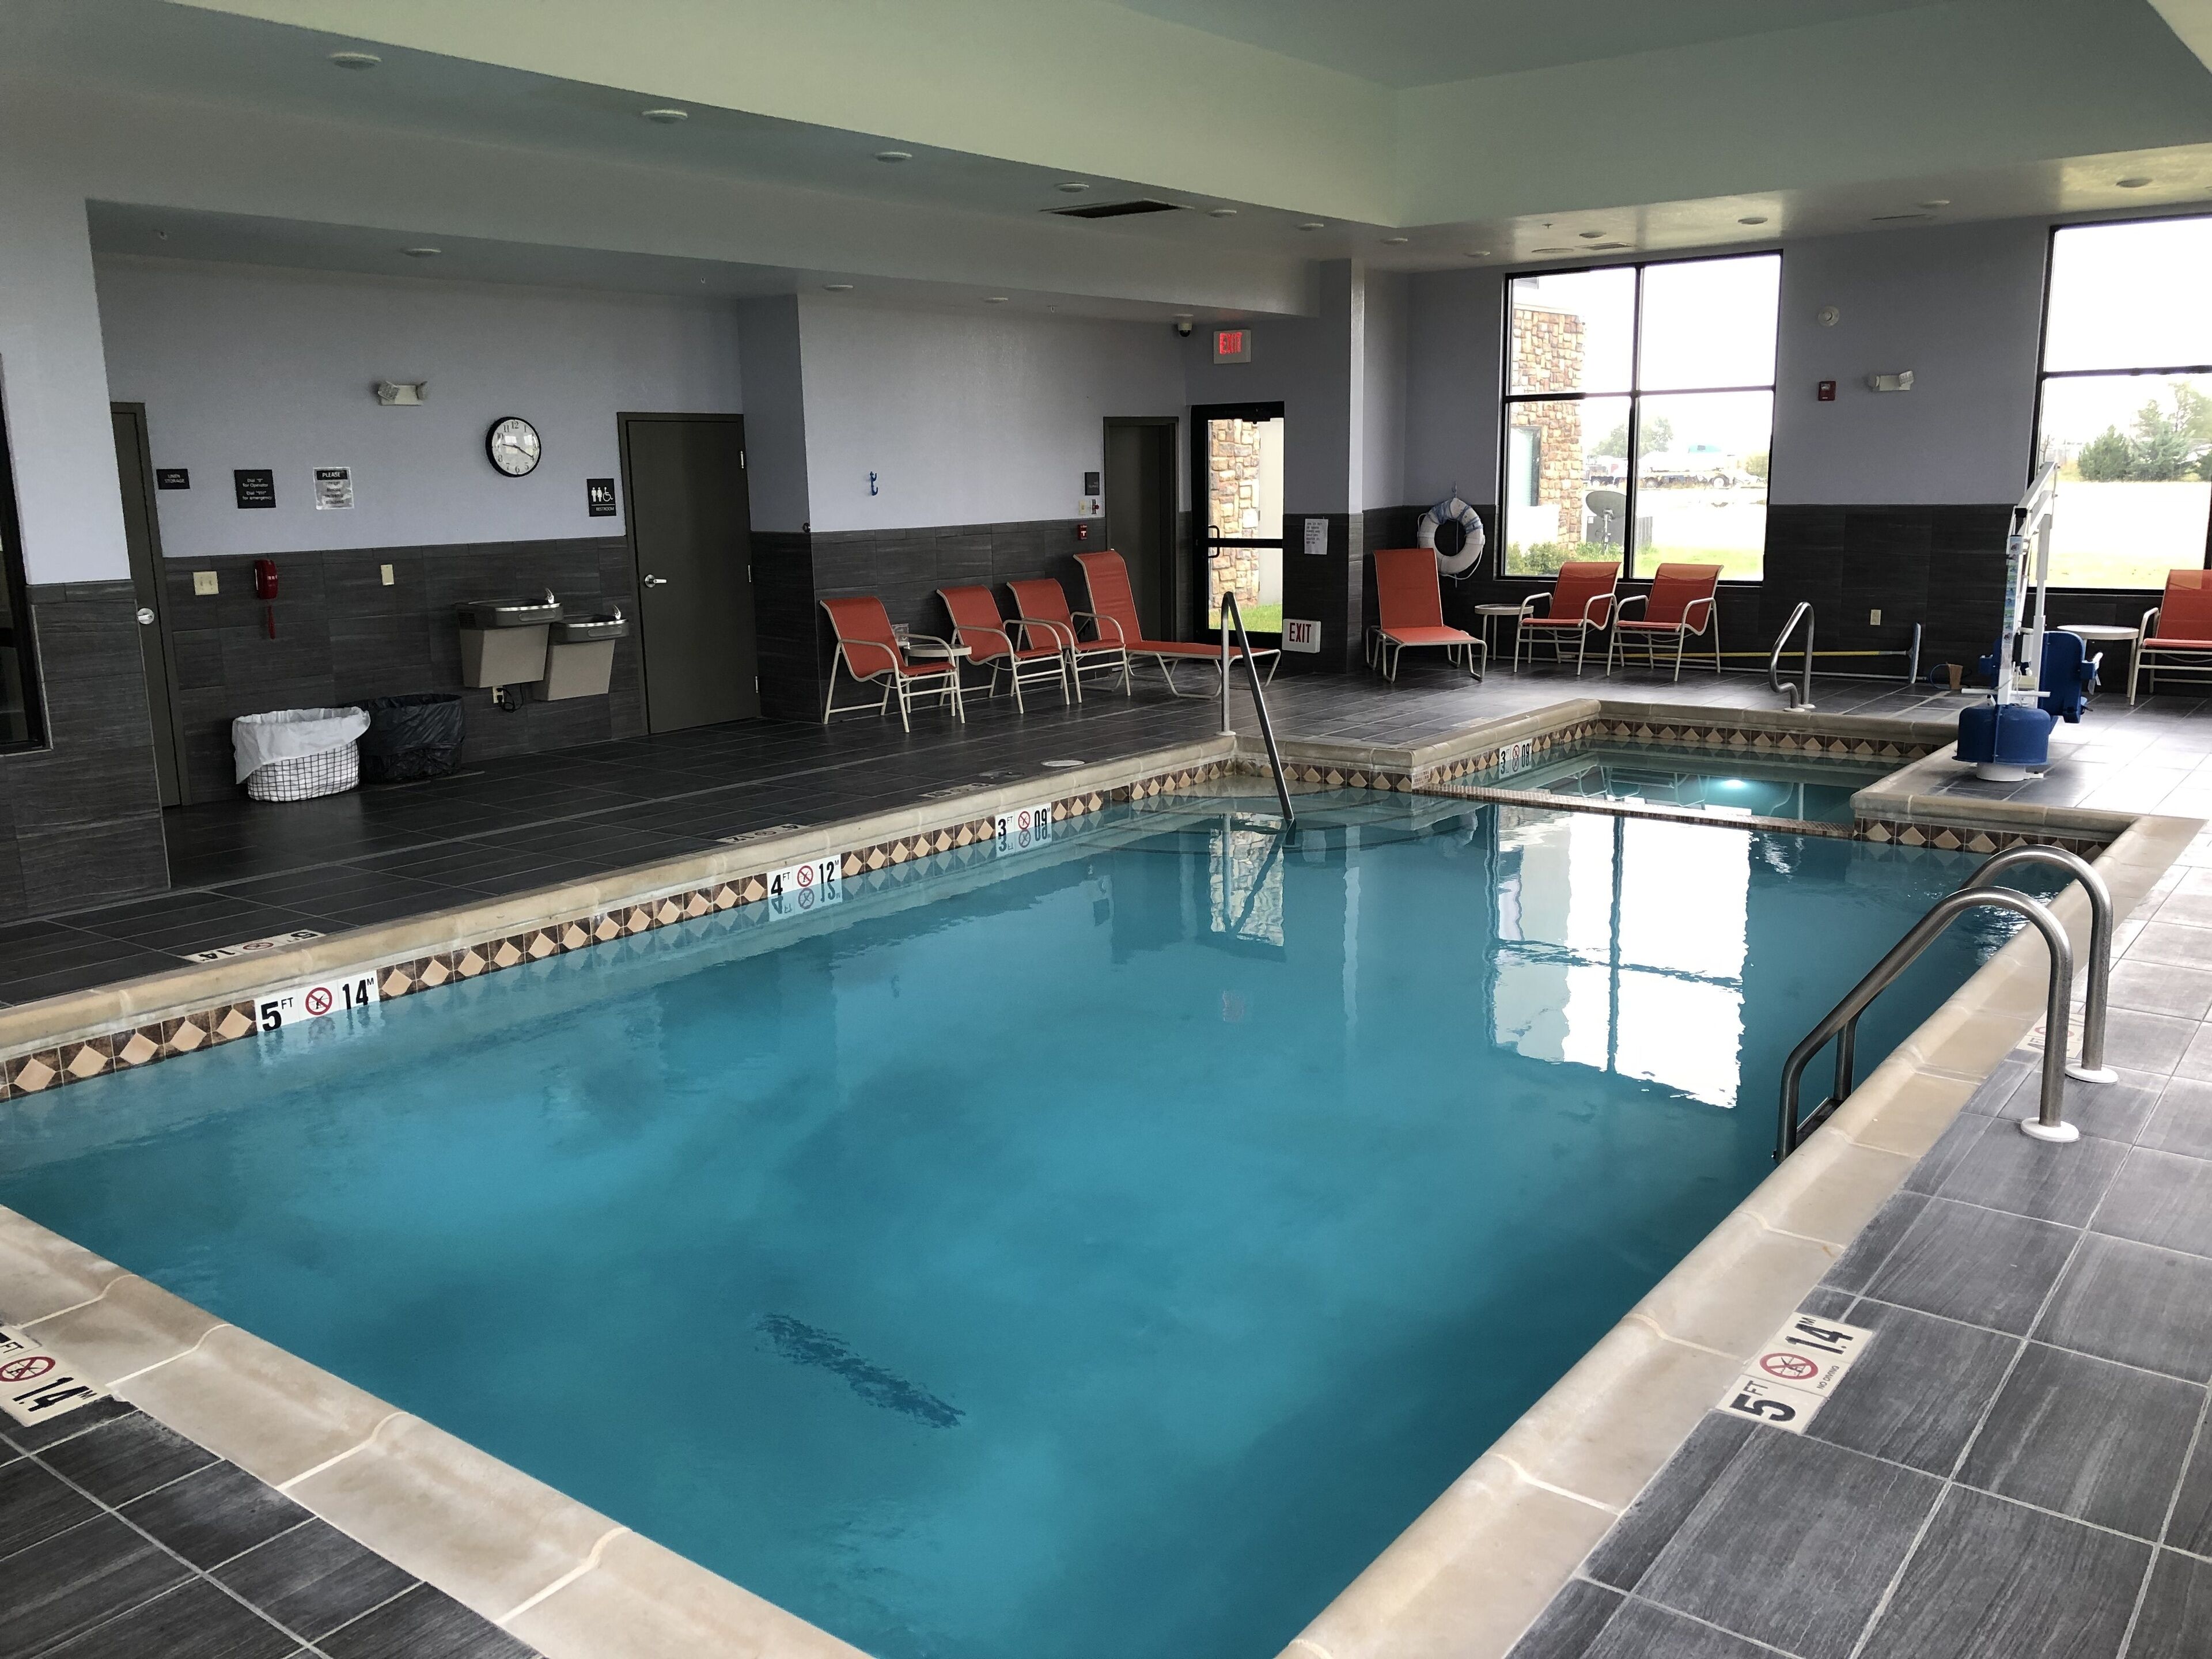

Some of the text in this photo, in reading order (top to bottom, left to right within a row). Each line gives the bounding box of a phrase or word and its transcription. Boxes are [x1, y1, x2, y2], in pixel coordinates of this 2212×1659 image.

[1219, 332, 1243, 354] EXIT
[512, 421, 519, 429] 12
[1289, 622, 1312, 643] EXIT
[1501, 751, 1506, 764] 3
[998, 819, 1006, 836] 3
[771, 874, 783, 896] 4
[260, 1001, 282, 1031] 5
[1743, 1380, 1768, 1396] FT
[1816, 1365, 1840, 1391] NO DIVING
[1729, 1392, 1796, 1422] 5
